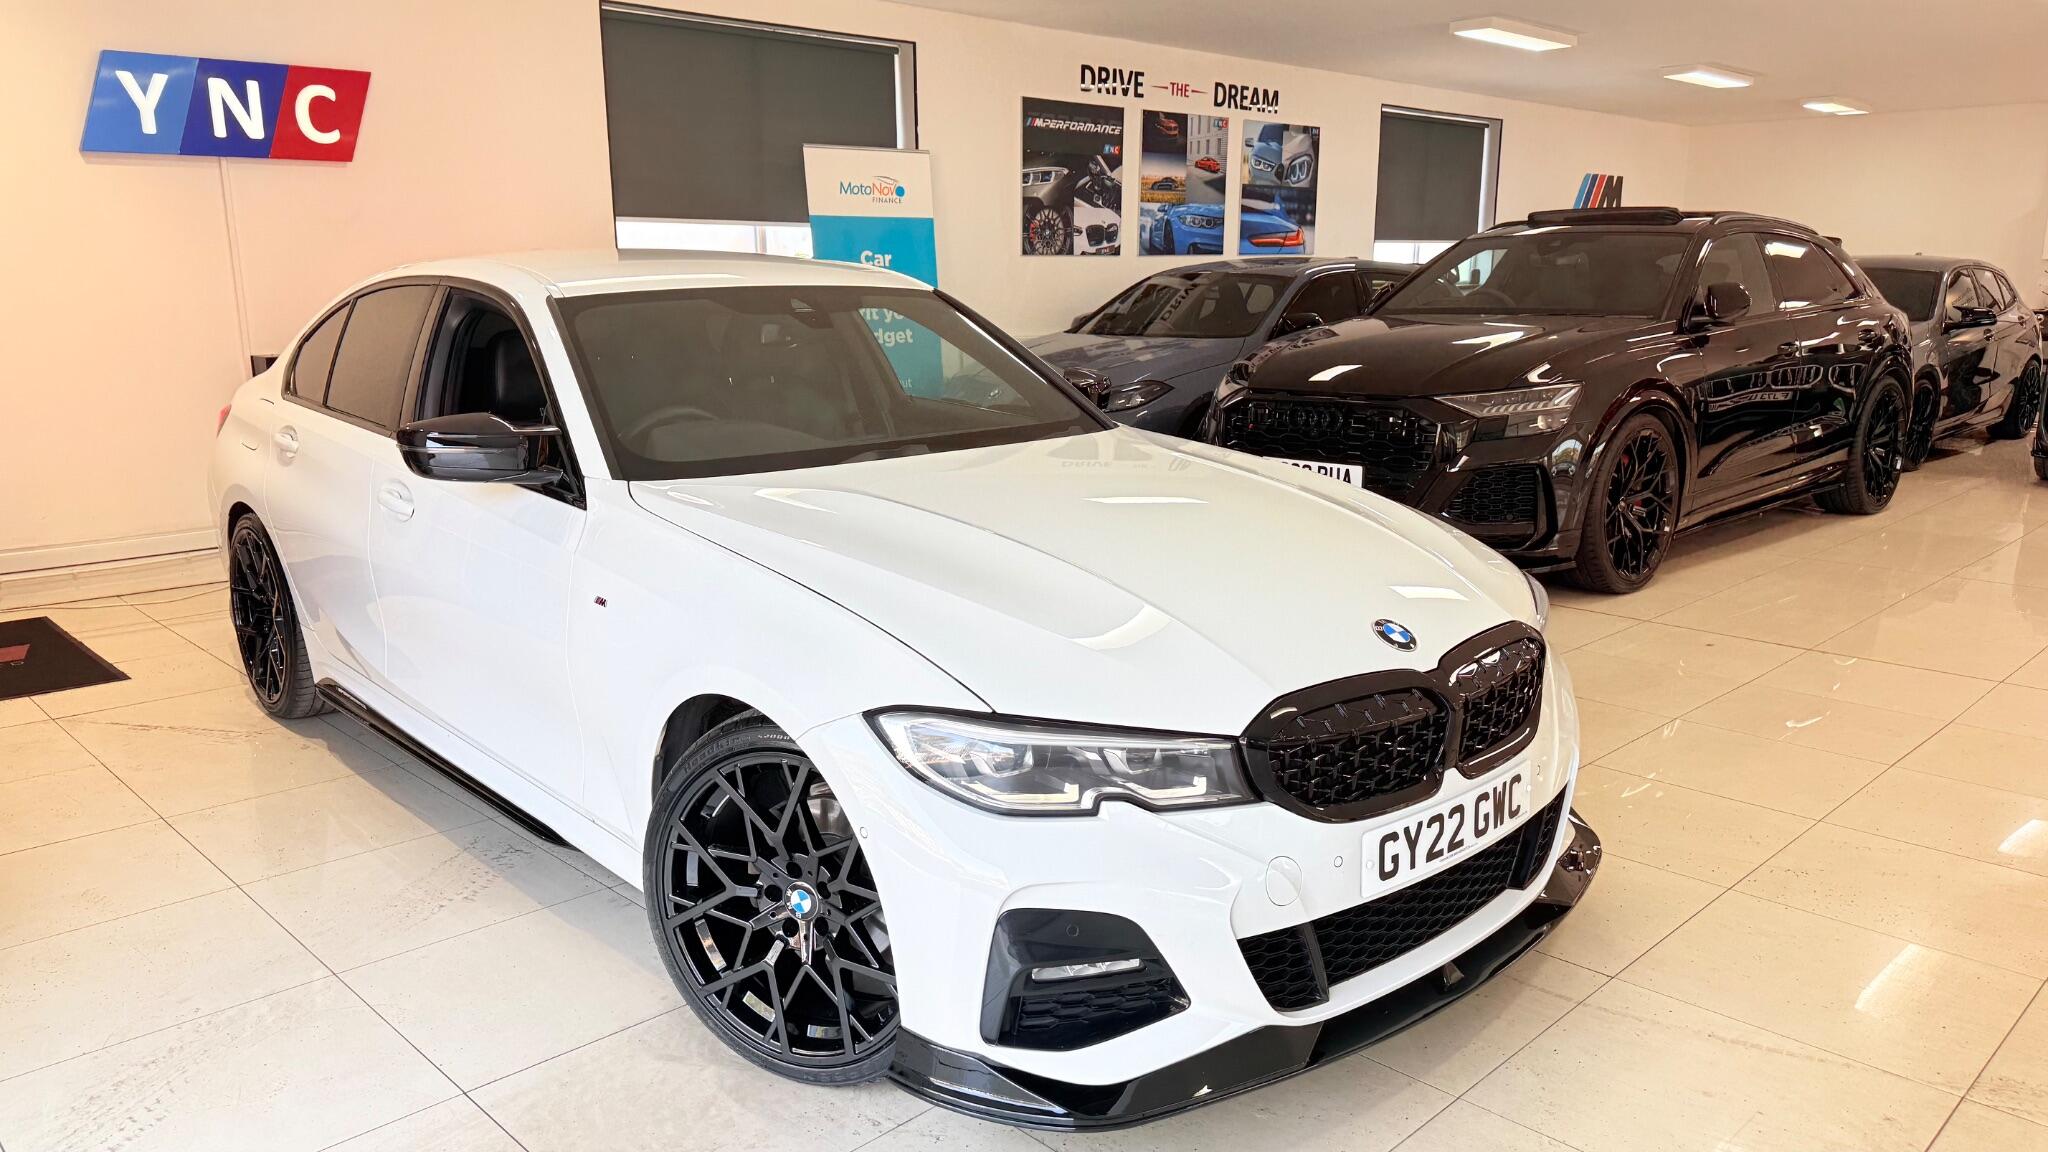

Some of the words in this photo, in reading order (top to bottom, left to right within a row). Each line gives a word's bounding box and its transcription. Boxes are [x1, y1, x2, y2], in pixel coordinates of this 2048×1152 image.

[114, 69, 342, 145] YNC
[1080, 63, 1145, 98] DRIVE
[1169, 81, 1190, 98] THE
[1213, 81, 1279, 114] DREAM
[860, 250, 892, 267] Car
[874, 328, 914, 347] dget
[1378, 803, 1465, 881] GY22
[1473, 773, 1522, 839] GWC
